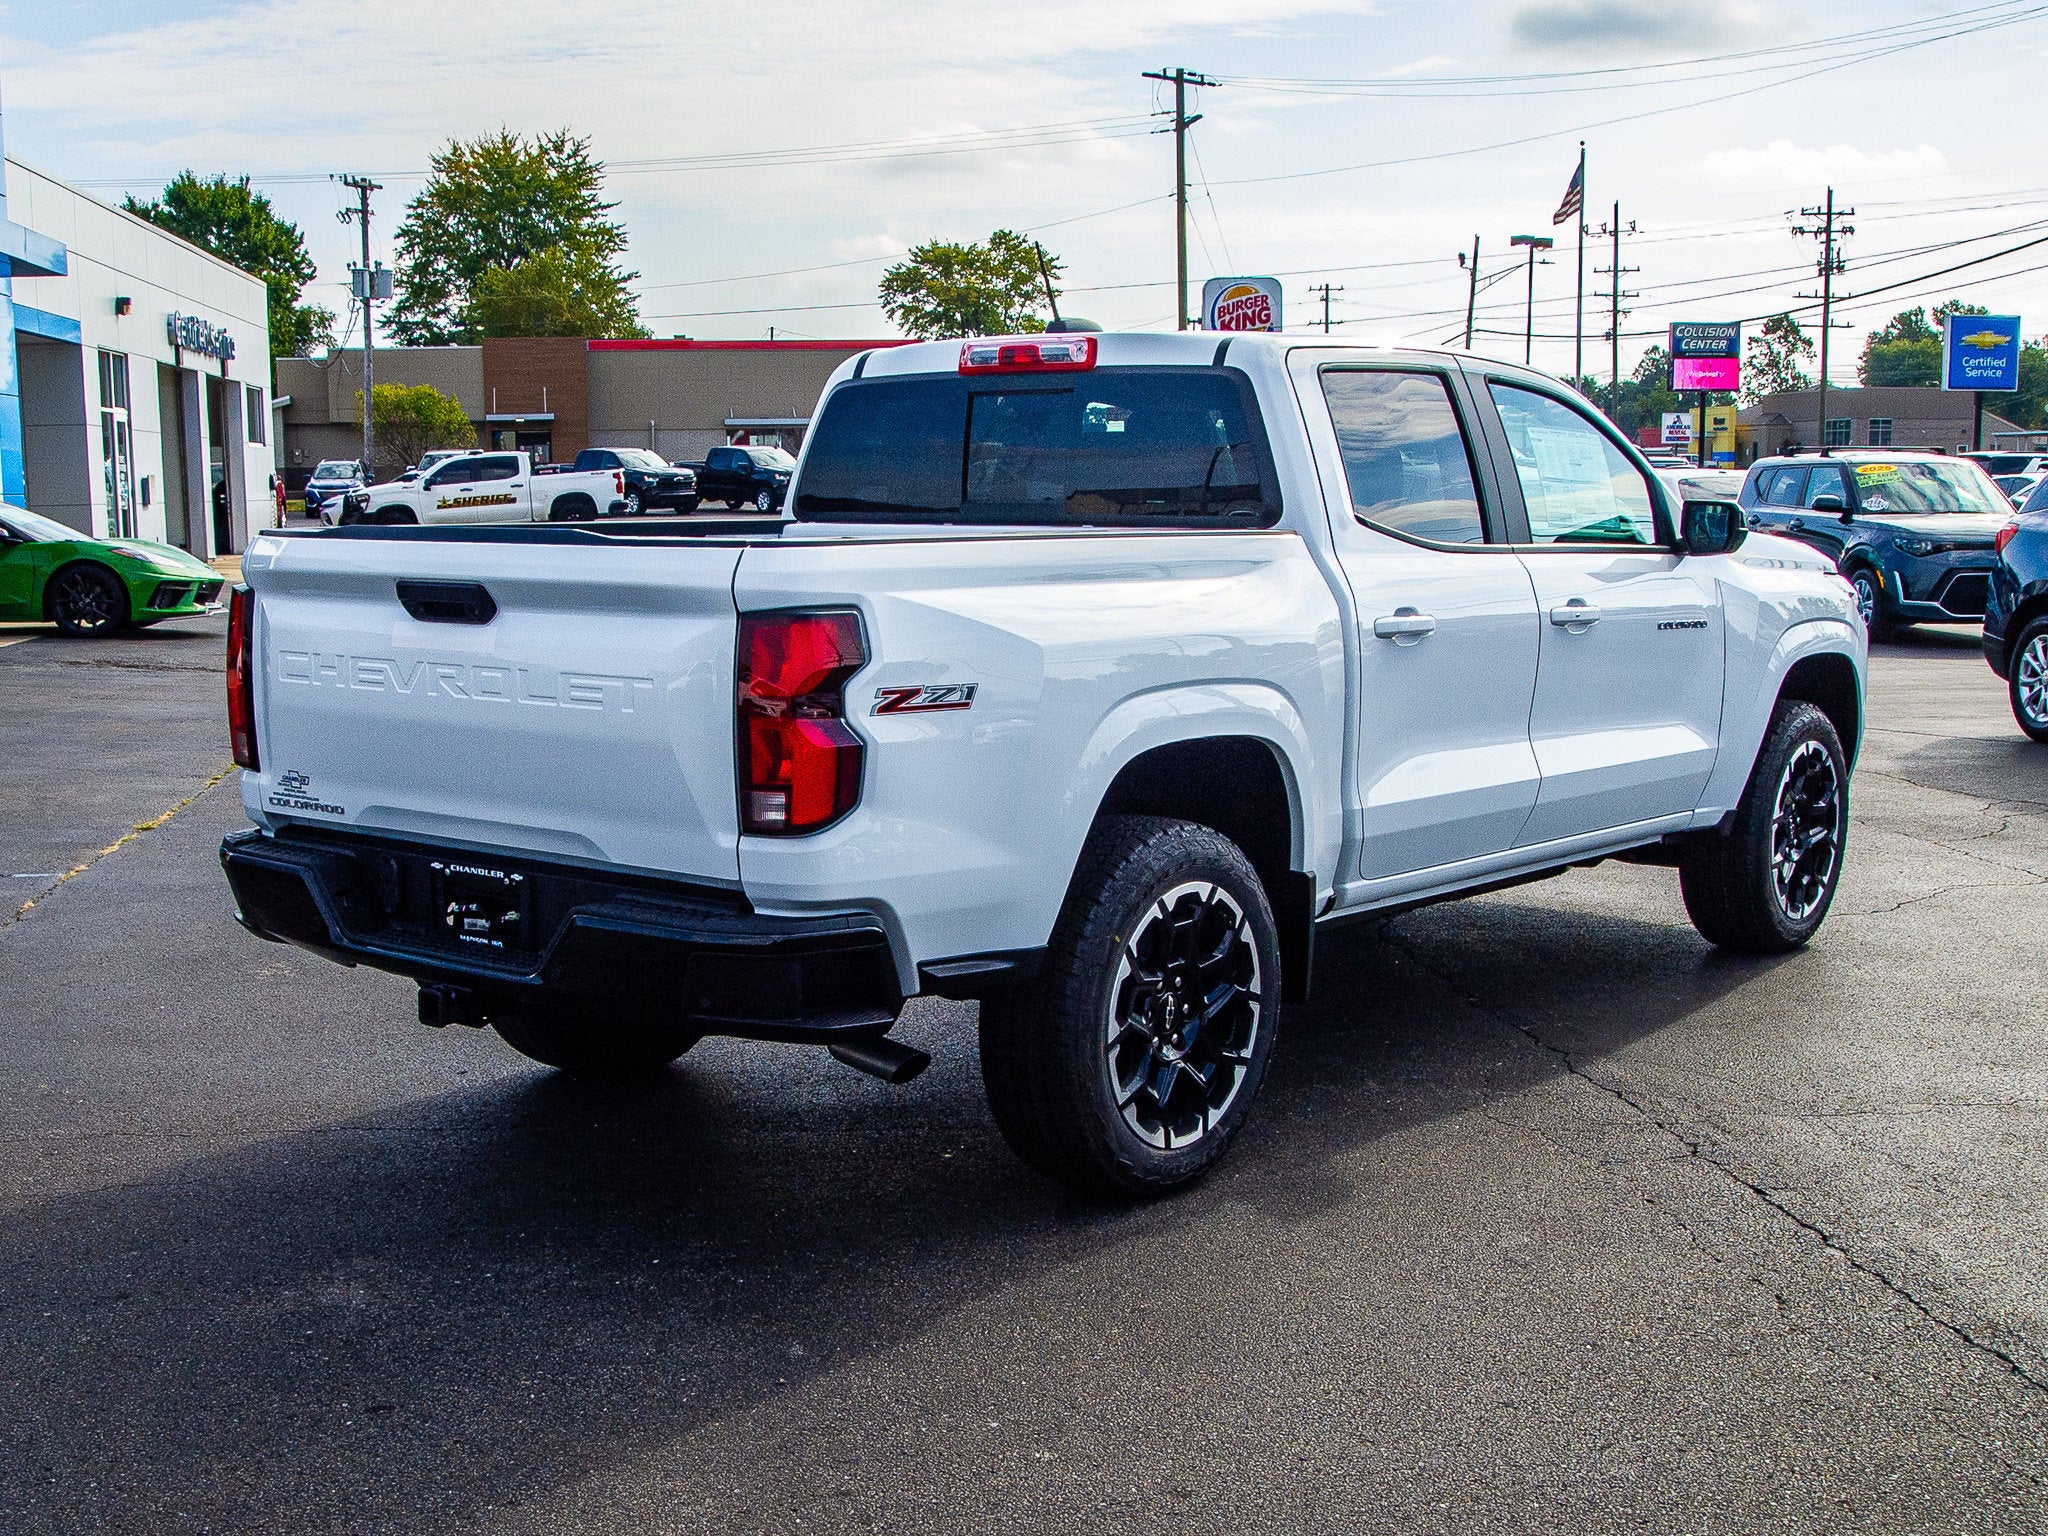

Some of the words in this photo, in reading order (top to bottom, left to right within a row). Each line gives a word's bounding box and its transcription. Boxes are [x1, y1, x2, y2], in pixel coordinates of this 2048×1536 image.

[1217, 294, 1269, 320] BURGER
[1220, 306, 1271, 331] KING
[1675, 325, 1737, 337] COLLISION
[1681, 338, 1728, 350] CENTER
[1962, 356, 2007, 367] Certified
[1965, 367, 2003, 377] Service
[1861, 465, 1892, 473] 2025
[452, 493, 513, 506] SHERIFF
[1657, 621, 1708, 630] COLORADO
[278, 650, 654, 713] CHEVROLET
[869, 683, 979, 717] Z71
[268, 797, 346, 815] COLORADO
[450, 864, 504, 878] CHANDLER
